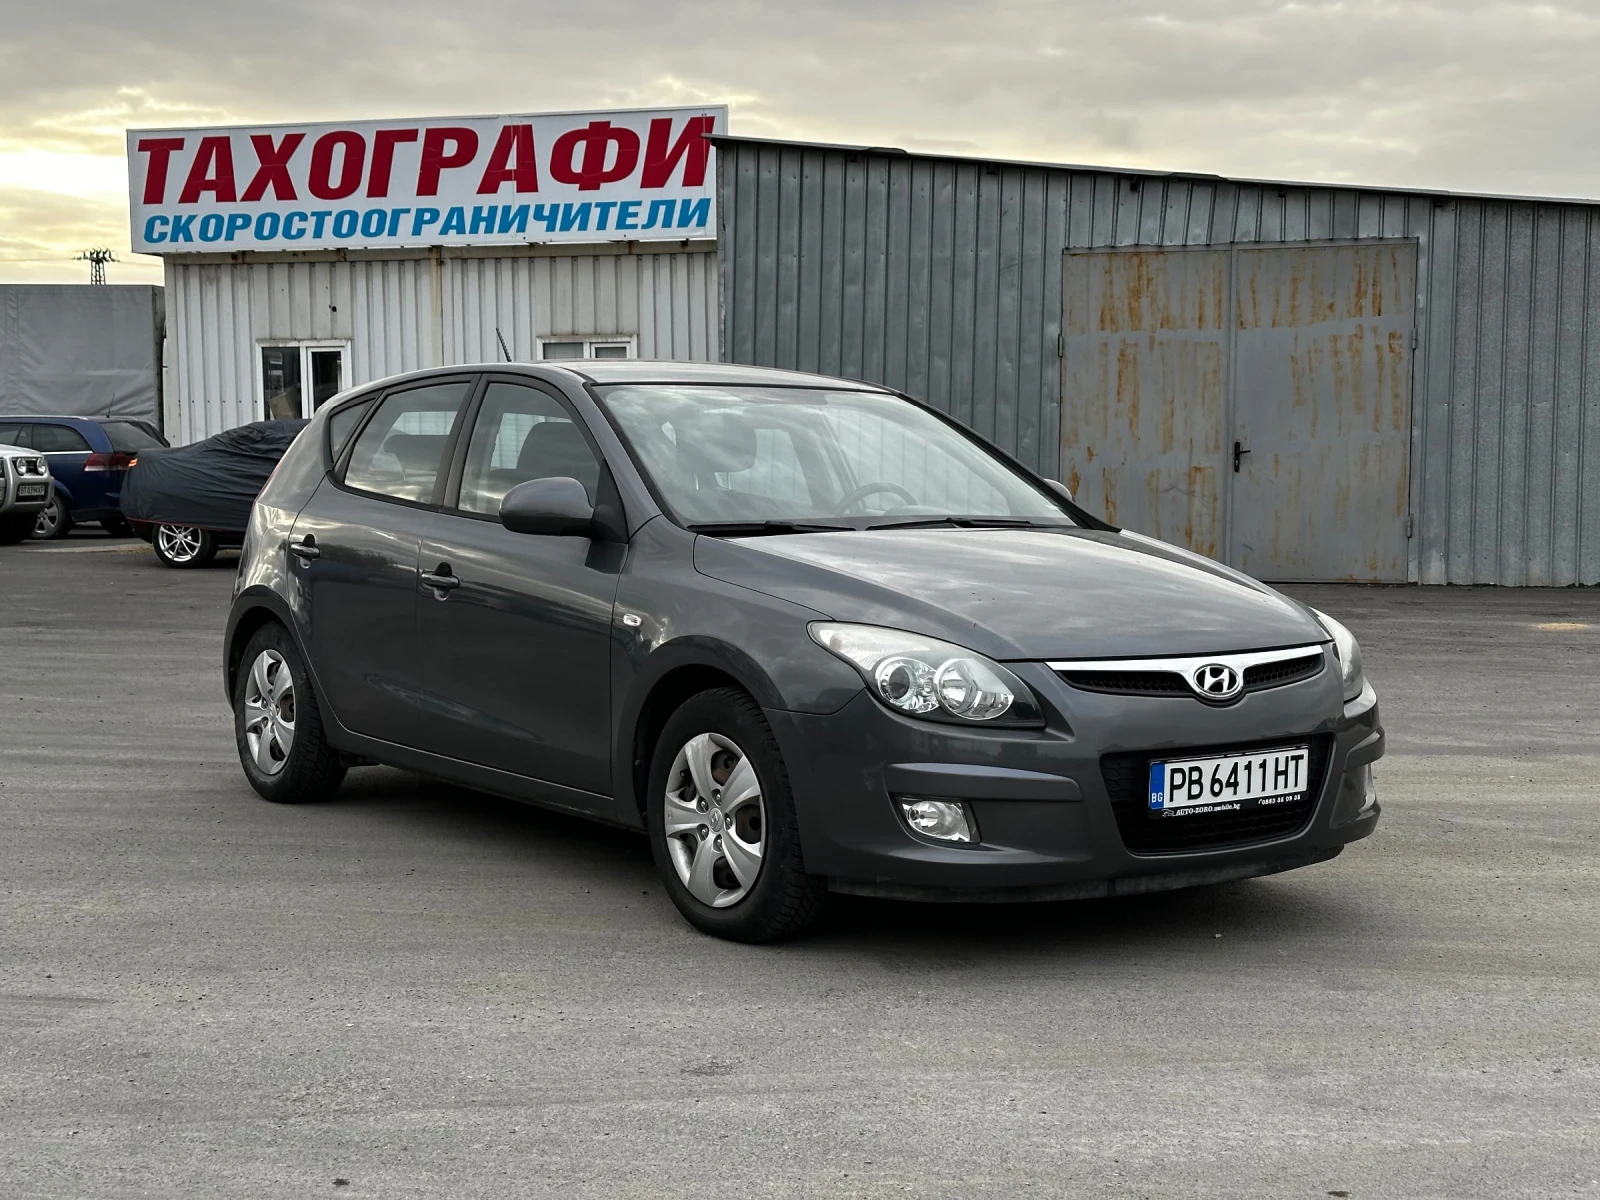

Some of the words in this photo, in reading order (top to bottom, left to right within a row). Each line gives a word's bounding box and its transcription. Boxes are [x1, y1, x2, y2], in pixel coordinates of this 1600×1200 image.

[137, 116, 715, 204] ТАХОГРАФИ
[143, 198, 711, 244] СКОРОСТООГРАНИЧИТЕЛИ
[1151, 792, 1164, 803] BG
